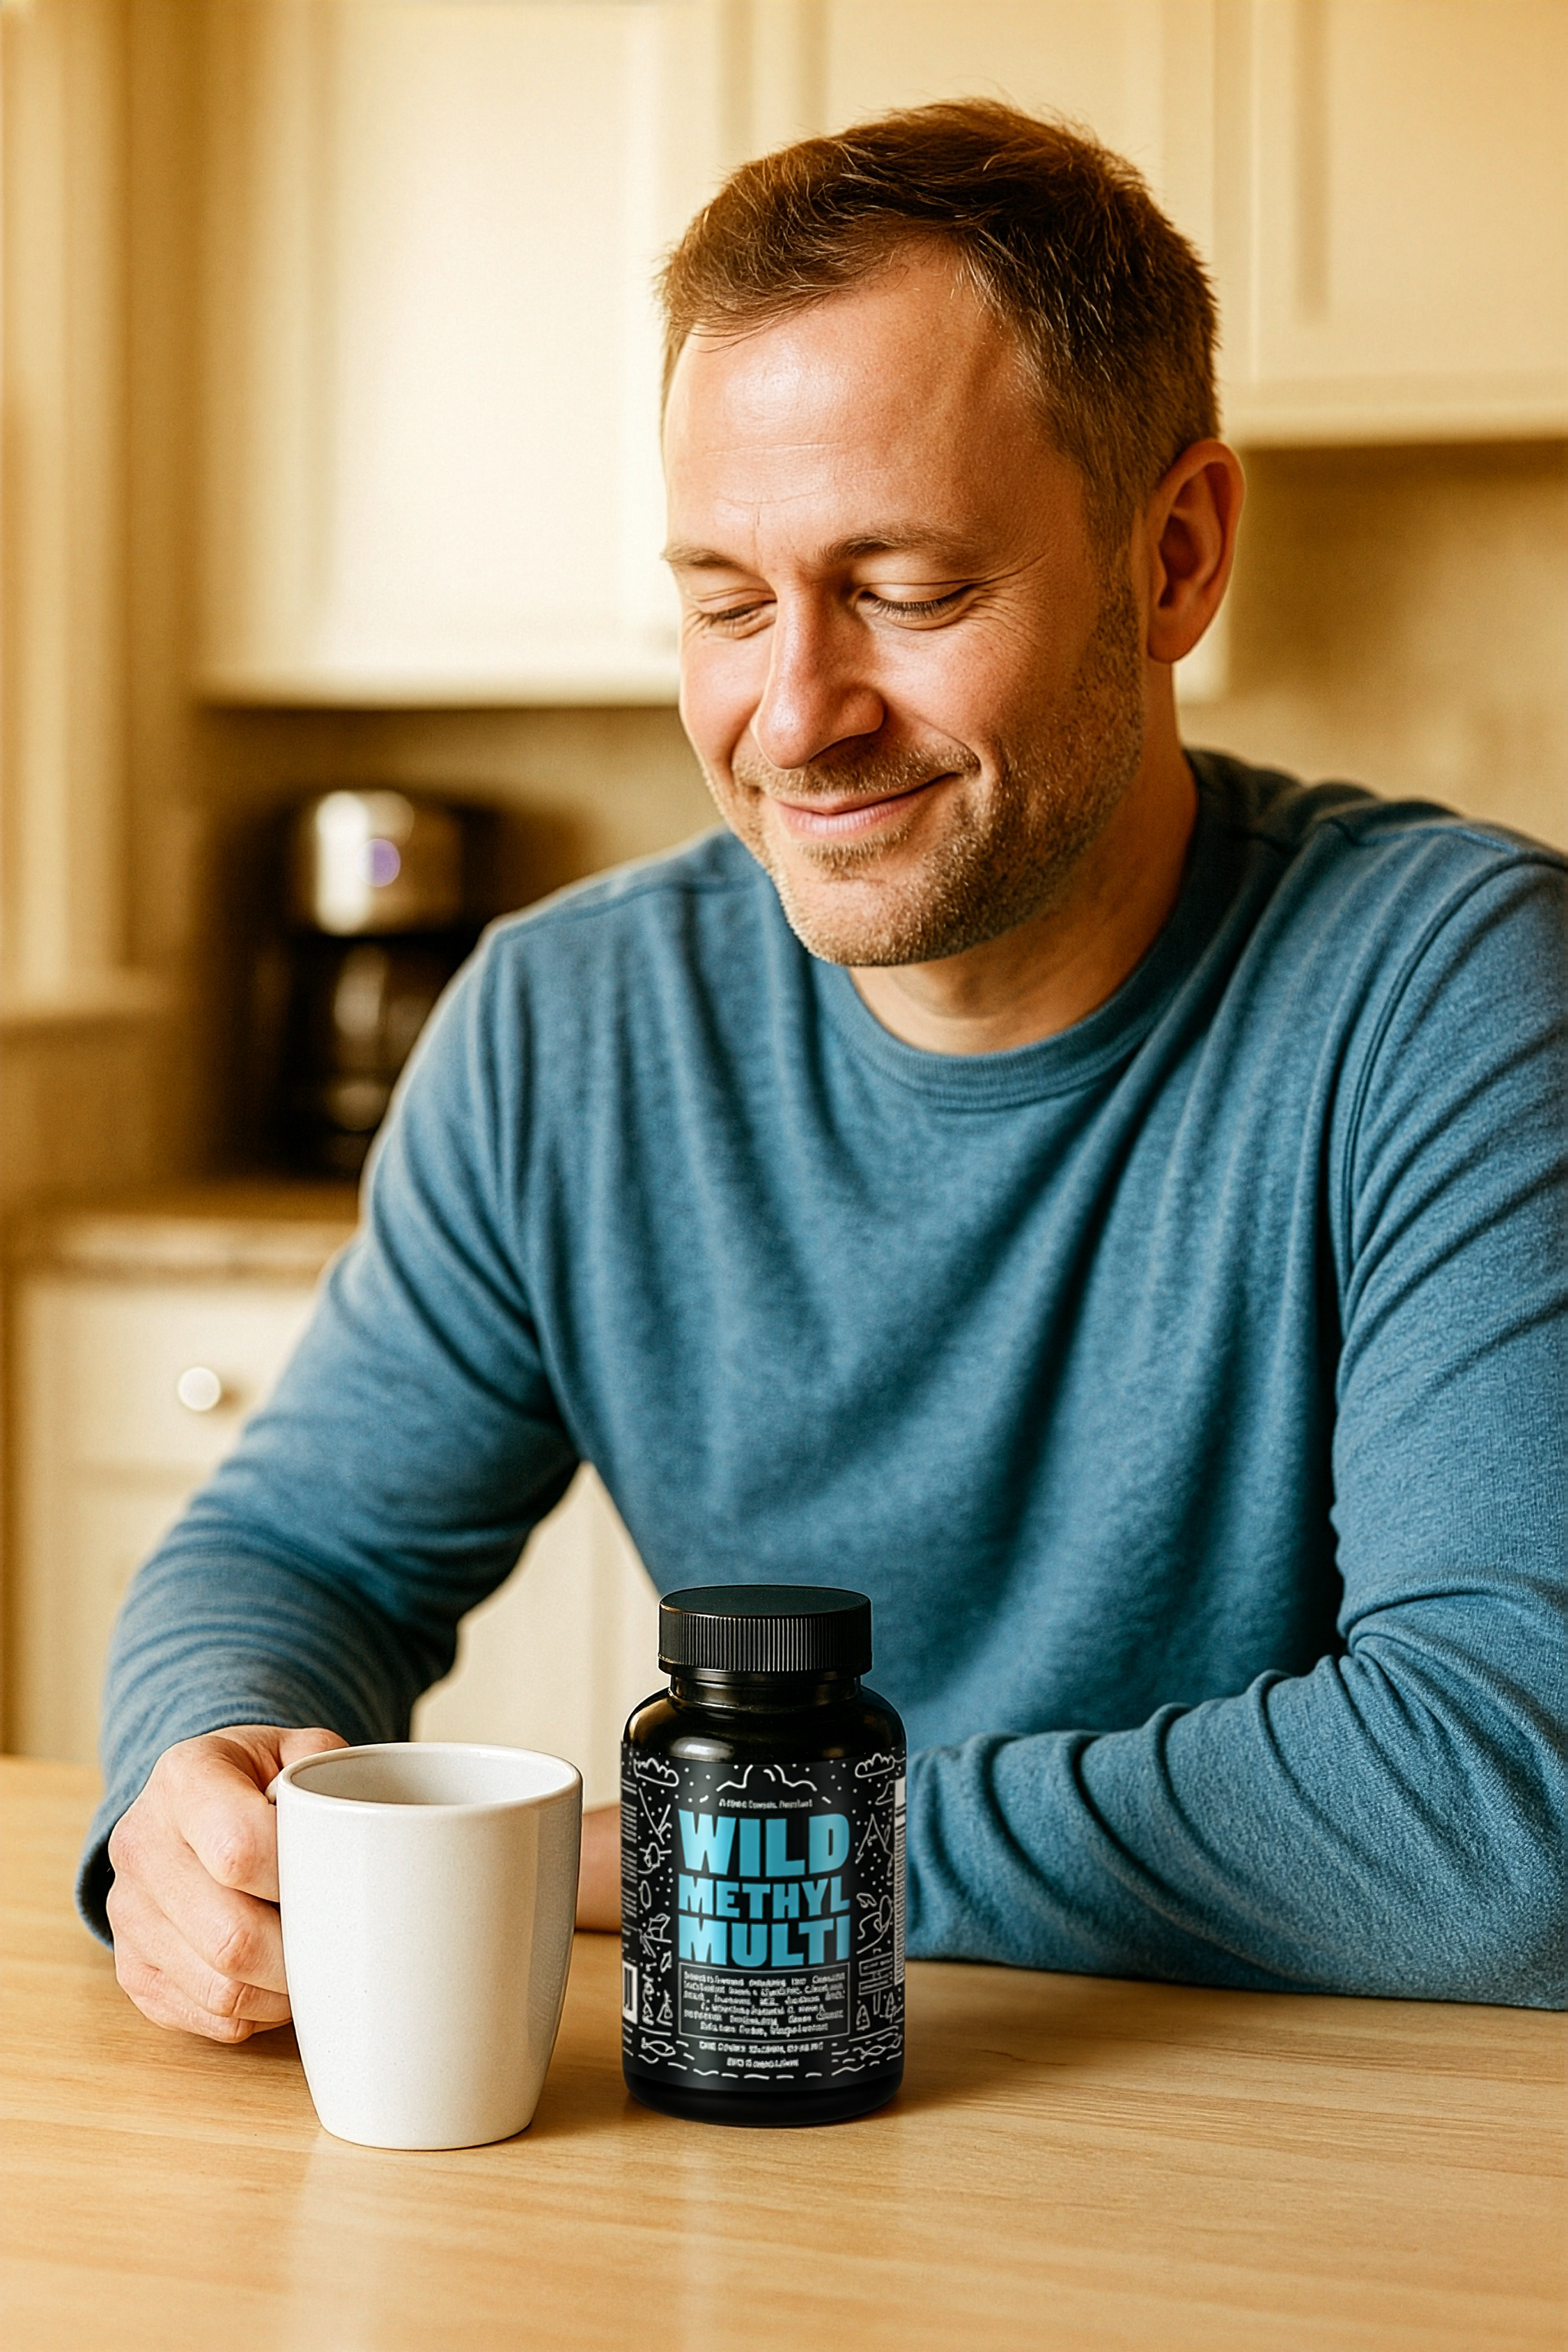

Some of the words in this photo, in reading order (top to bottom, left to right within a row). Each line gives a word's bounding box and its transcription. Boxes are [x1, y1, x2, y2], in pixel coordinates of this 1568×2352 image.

[678, 1808, 851, 1877] WILD
[678, 1873, 851, 1919] METHYL
[678, 1914, 851, 1967] MULTI
